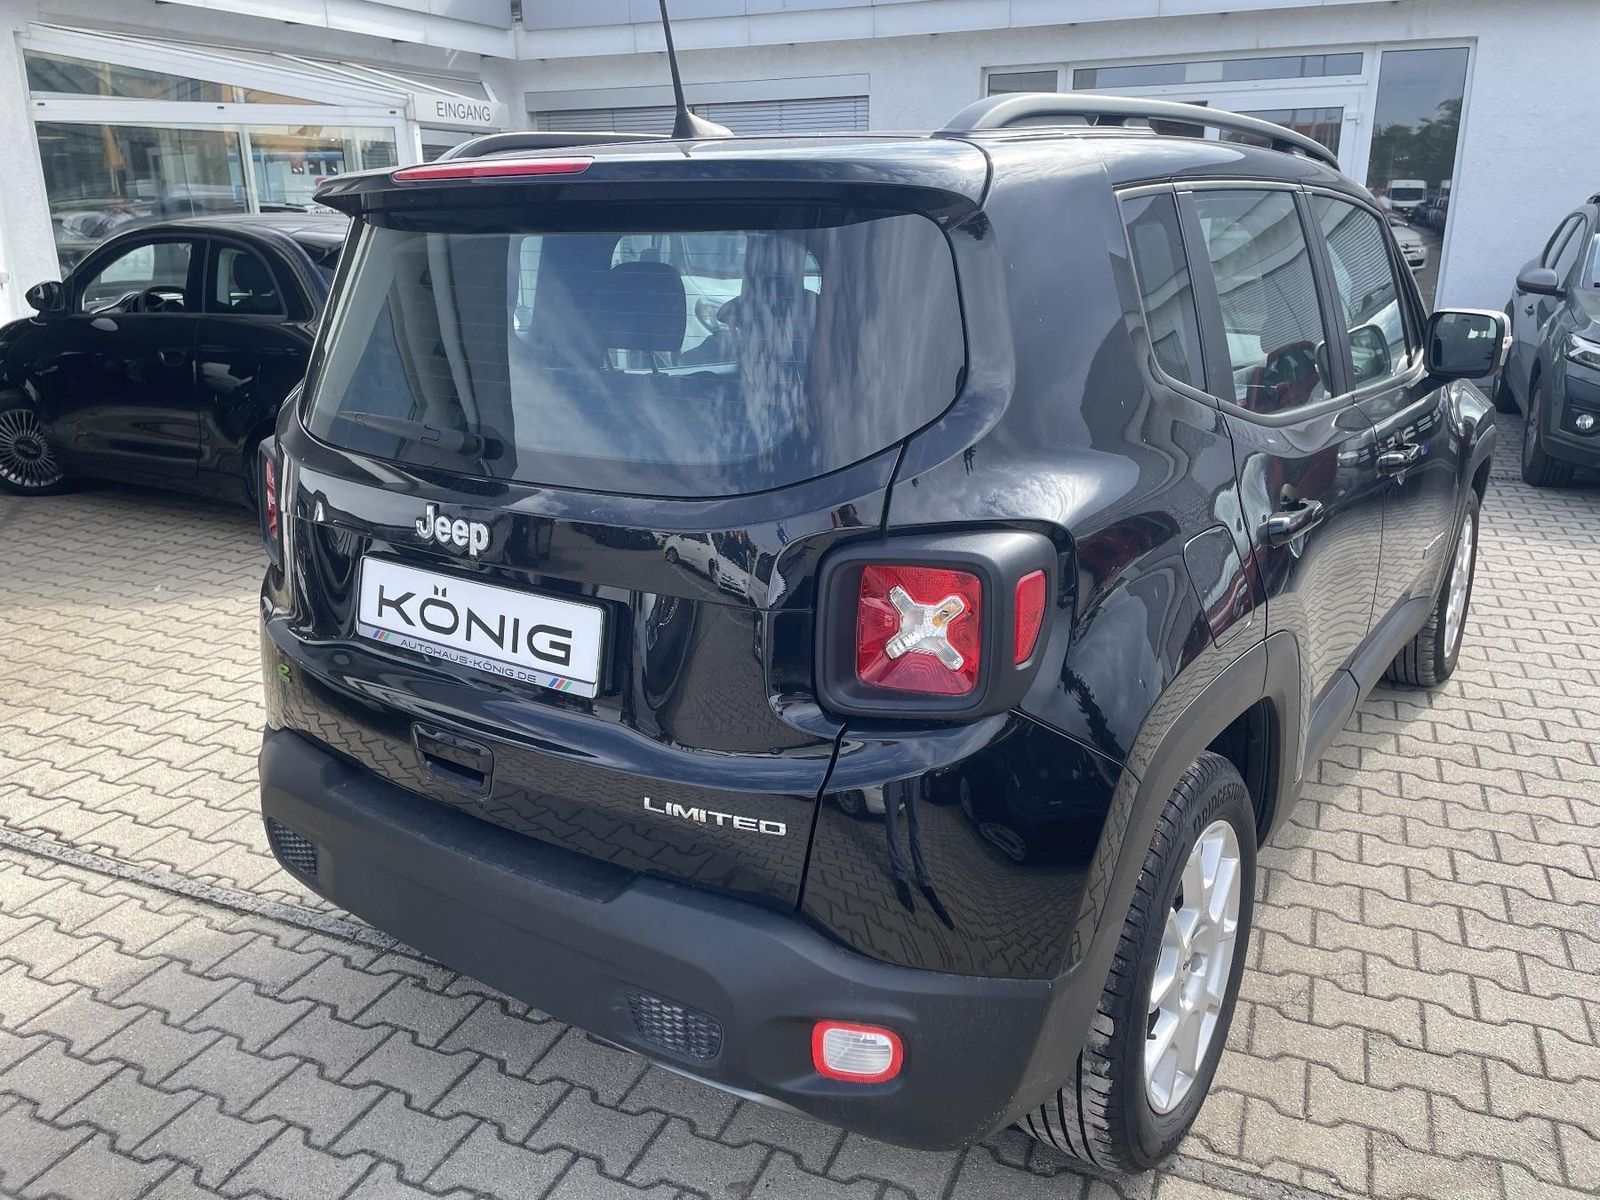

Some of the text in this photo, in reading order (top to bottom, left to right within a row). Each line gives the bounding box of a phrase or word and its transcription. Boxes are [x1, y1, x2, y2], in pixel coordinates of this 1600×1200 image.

[436, 101, 491, 121] EINGANG
[415, 504, 489, 556] Jeep
[377, 584, 573, 667] KÖNIG
[400, 639, 537, 684] AUTOHAUS-KÖNIG.DE
[643, 796, 787, 836] LIMITED
